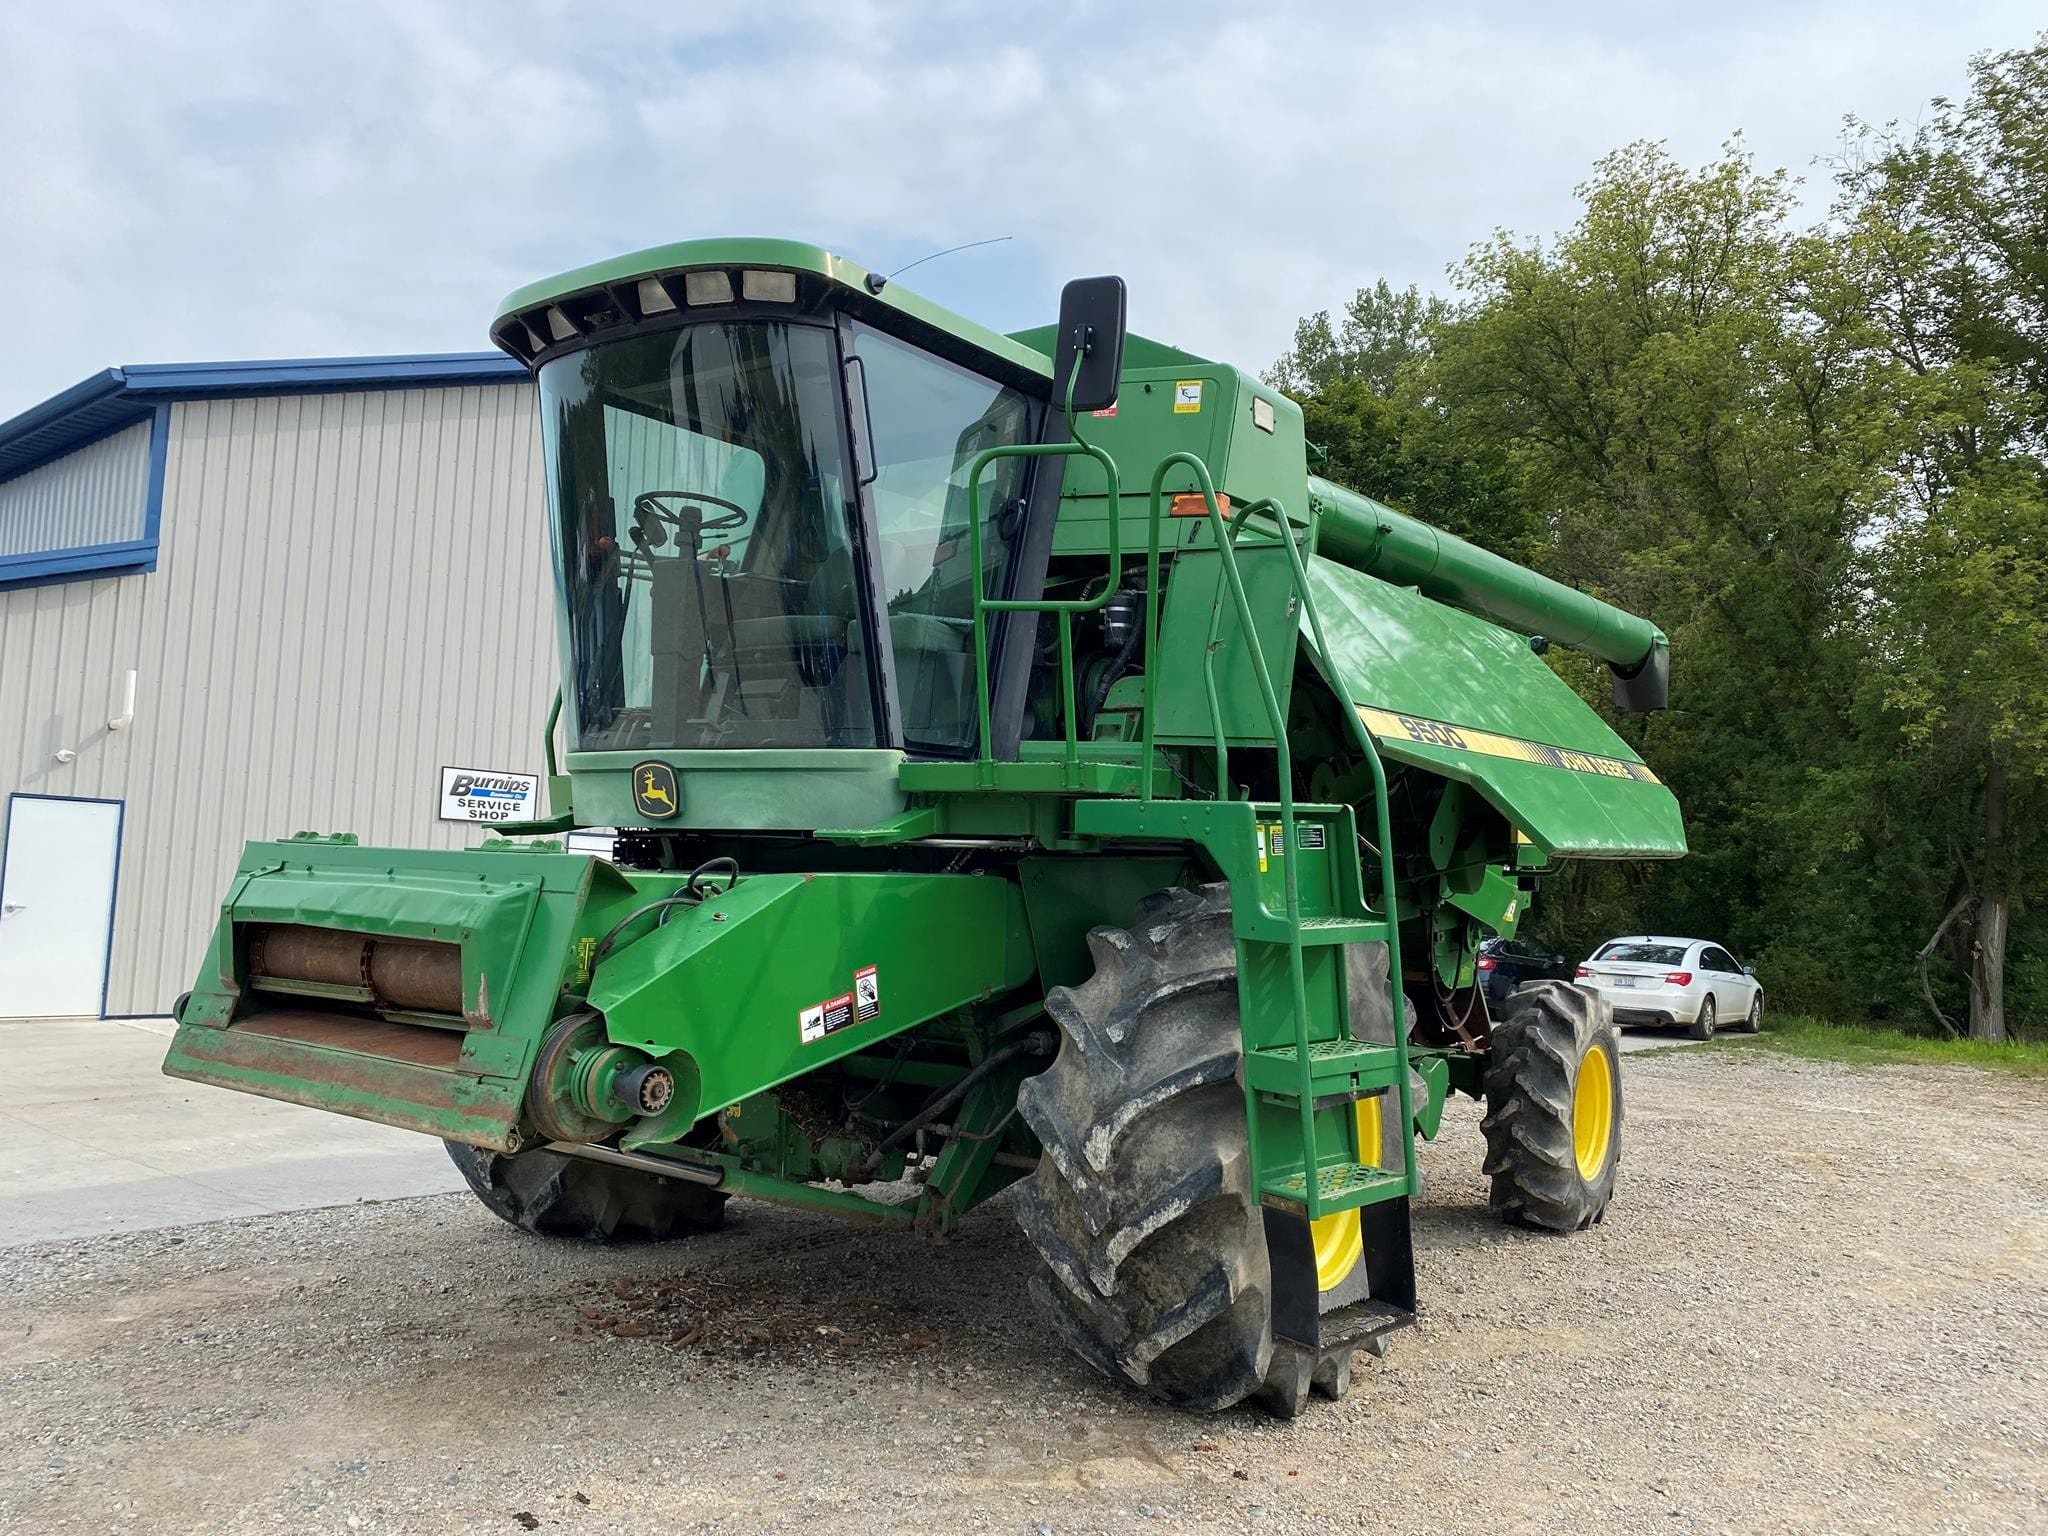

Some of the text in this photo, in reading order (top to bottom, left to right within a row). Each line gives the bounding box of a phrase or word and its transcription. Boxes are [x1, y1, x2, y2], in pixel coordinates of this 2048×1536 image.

[1398, 717, 1467, 749] 9500
[1555, 749, 1598, 774] JOHN
[449, 774, 531, 797] Burnips
[457, 798, 521, 812] SERVICE
[469, 809, 509, 821] SHOP
